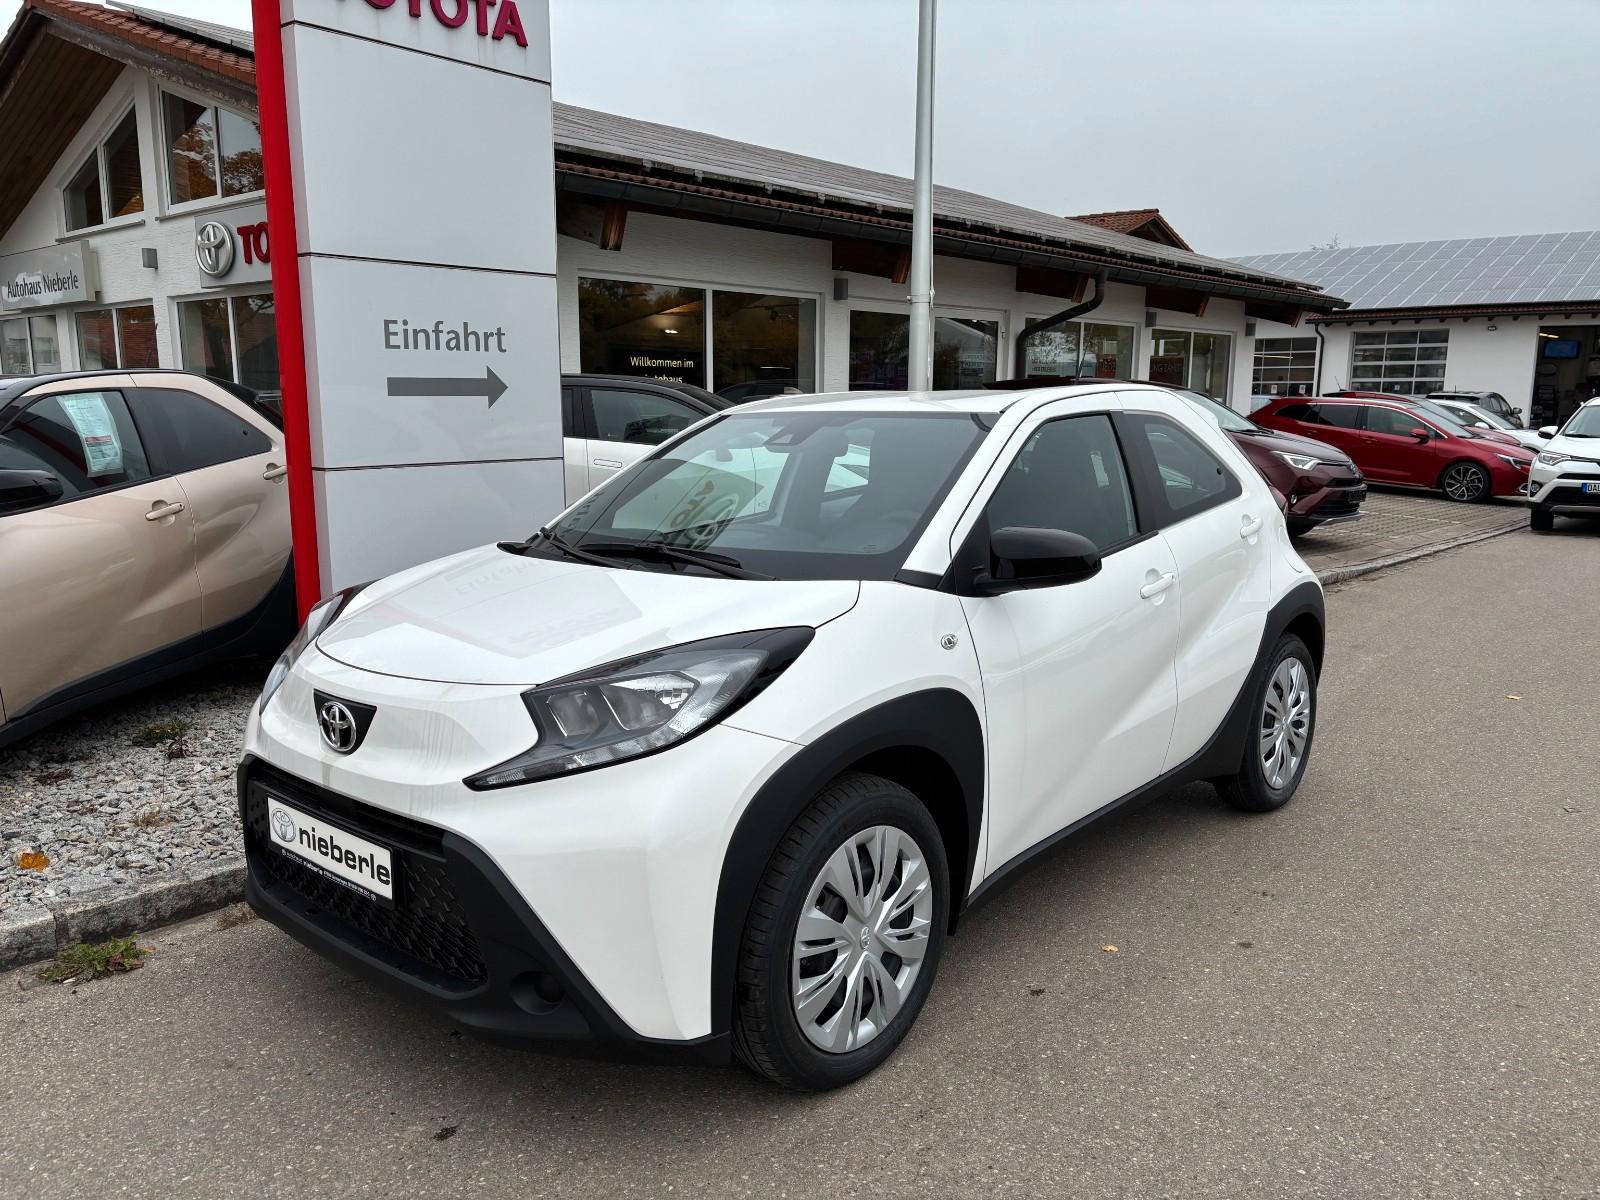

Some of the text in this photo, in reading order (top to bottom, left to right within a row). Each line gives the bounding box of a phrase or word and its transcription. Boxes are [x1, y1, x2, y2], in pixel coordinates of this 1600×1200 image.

[338, 0, 528, 48] OTA
[7, 269, 79, 298] Autohaus Nieberle
[383, 319, 507, 353] Einfahrt
[630, 356, 694, 368] Willkommen im
[299, 827, 391, 886] nieberle
